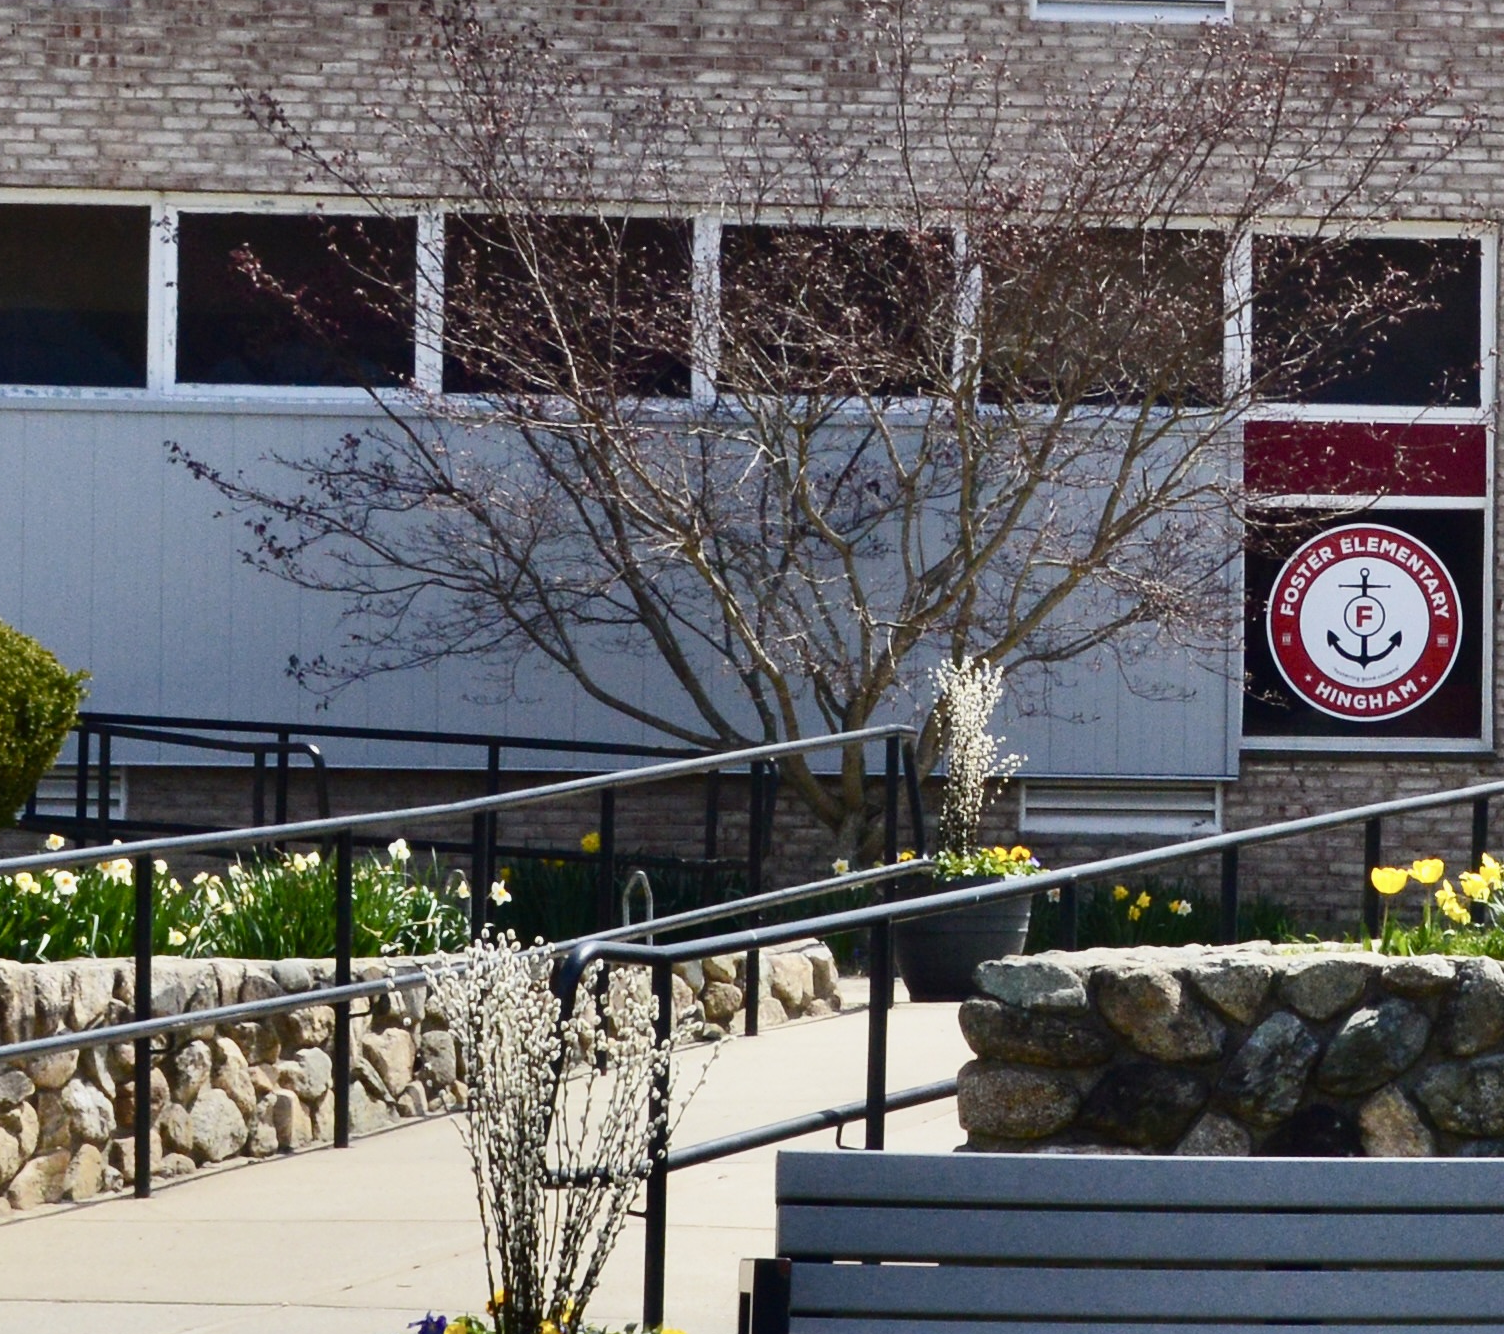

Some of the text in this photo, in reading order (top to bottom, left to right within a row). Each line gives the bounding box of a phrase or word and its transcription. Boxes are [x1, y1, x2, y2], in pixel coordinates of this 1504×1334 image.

[1280, 537, 1449, 619] FOSTER ELEMENTARY
[1356, 606, 1373, 627] F
[1315, 679, 1418, 709] HINGHAM
